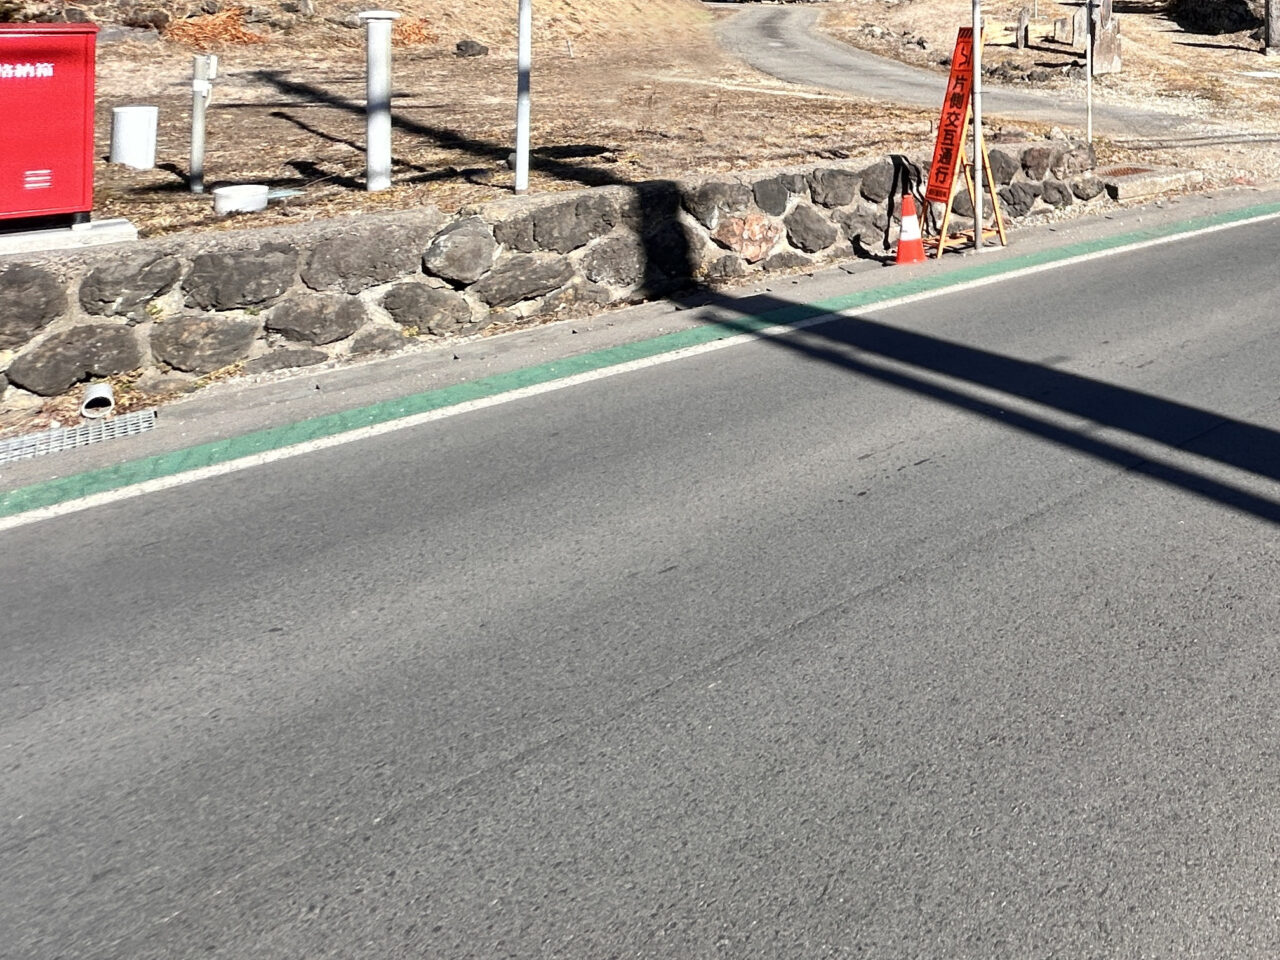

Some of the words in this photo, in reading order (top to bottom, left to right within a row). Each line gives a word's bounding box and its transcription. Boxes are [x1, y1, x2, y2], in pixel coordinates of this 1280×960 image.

[935, 74, 968, 184] 片側交互通行
